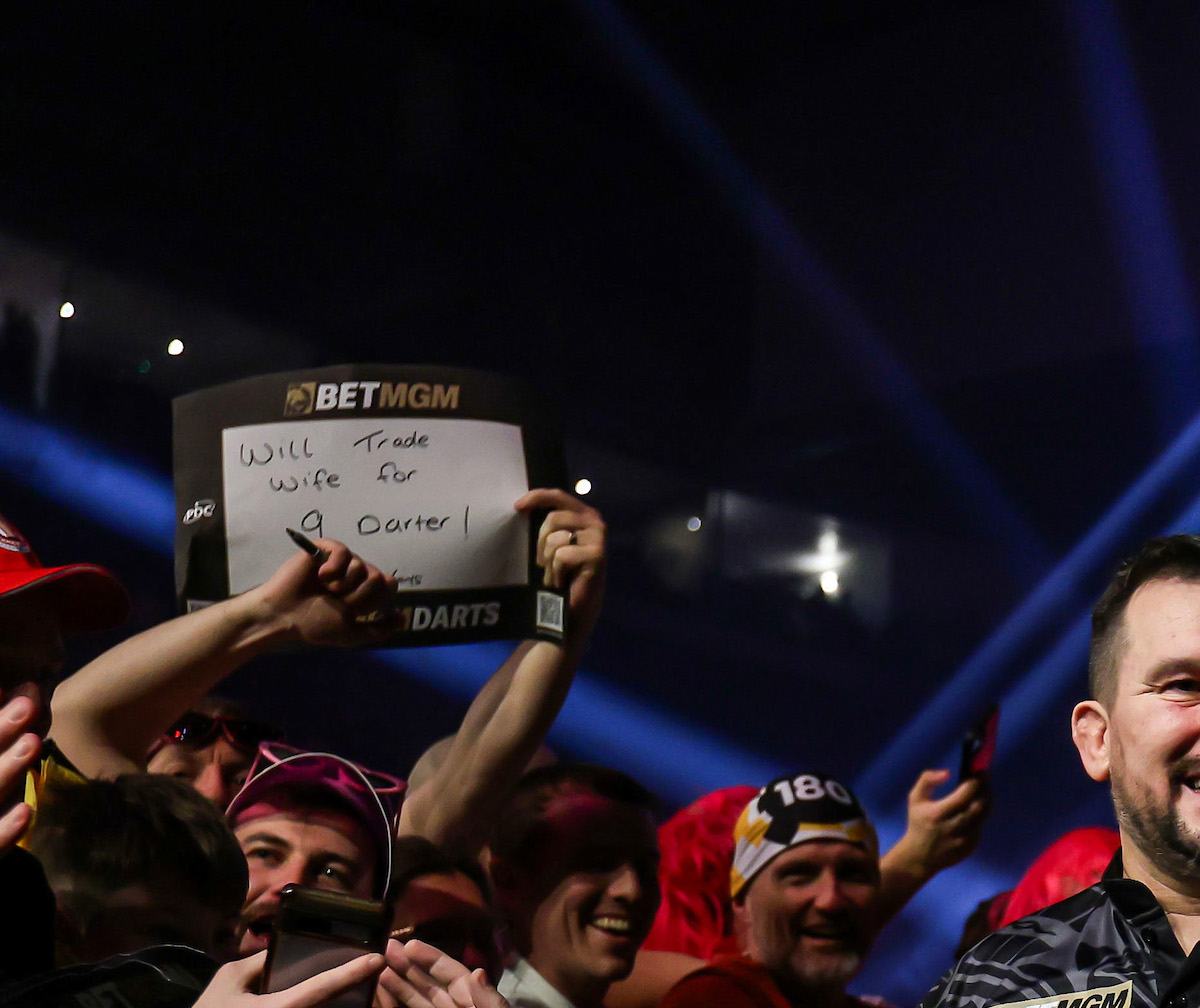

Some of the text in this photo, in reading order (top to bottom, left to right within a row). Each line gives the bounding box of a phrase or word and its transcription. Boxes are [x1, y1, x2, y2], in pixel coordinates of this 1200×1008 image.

[315, 381, 460, 411] BETMGM
[240, 430, 430, 467] Will Trade
[376, 462, 417, 484] for
[301, 509, 323, 539] 9
[773, 774, 852, 807] 180
